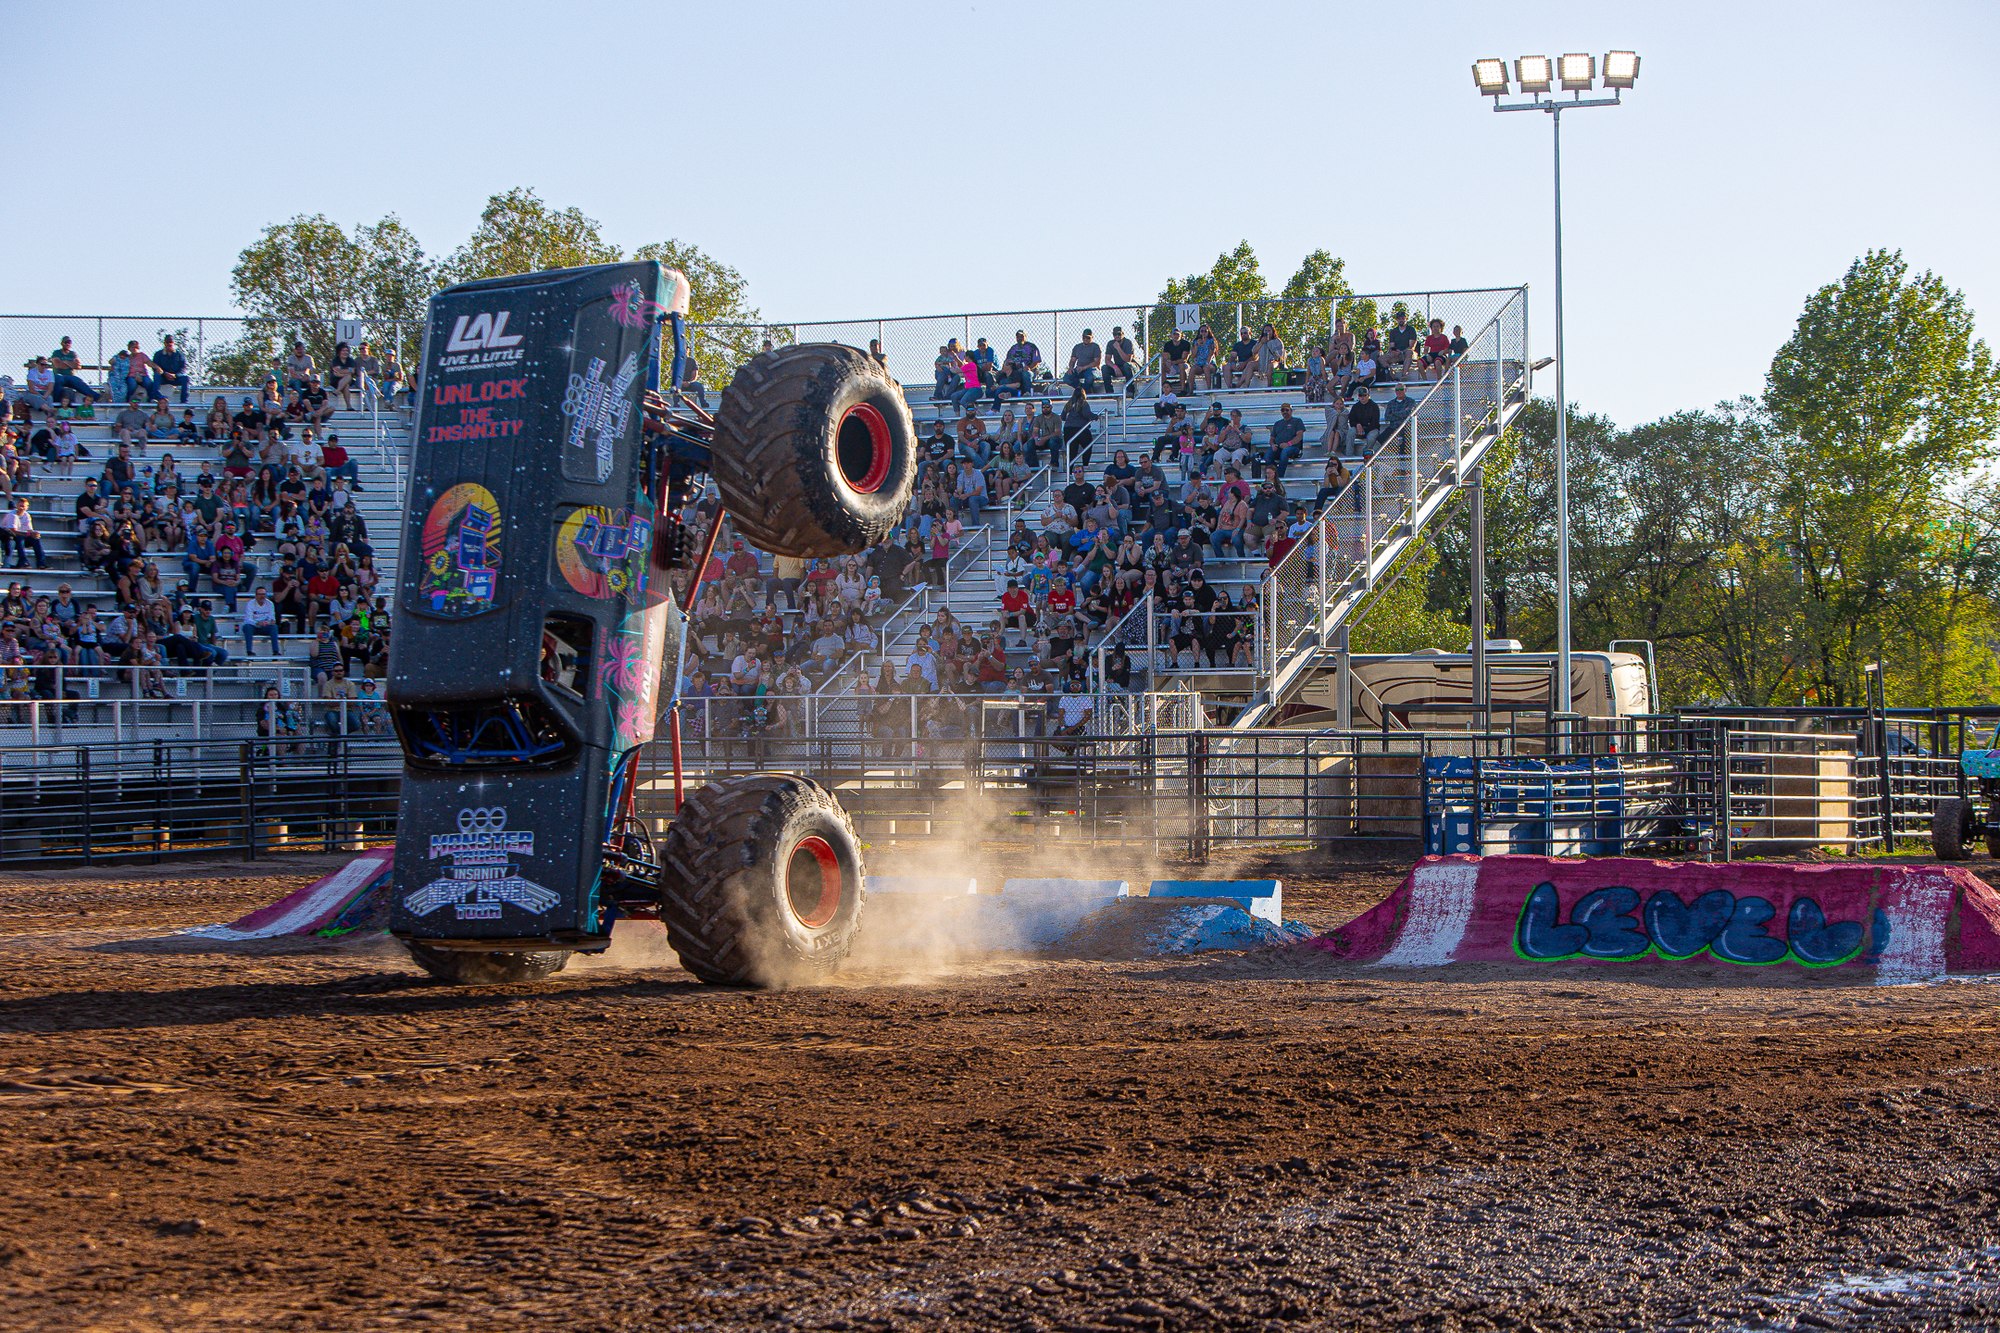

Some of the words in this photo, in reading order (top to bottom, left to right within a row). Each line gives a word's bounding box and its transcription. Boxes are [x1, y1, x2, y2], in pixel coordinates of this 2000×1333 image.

[1180, 309, 1197, 325] JK
[446, 311, 524, 352] LAL
[438, 355, 469, 367] LIVE
[469, 353, 480, 364] A
[482, 348, 525, 362] LITTLE
[434, 379, 529, 405] UNLOCK
[460, 407, 495, 424] THE
[427, 419, 524, 443] INSANITY
[429, 831, 534, 859] MONSTER
[453, 867, 508, 880] INSANITY
[427, 882, 470, 904] NEXT
[476, 880, 532, 903] LEVEL
[1516, 881, 1864, 967] LEVEL
